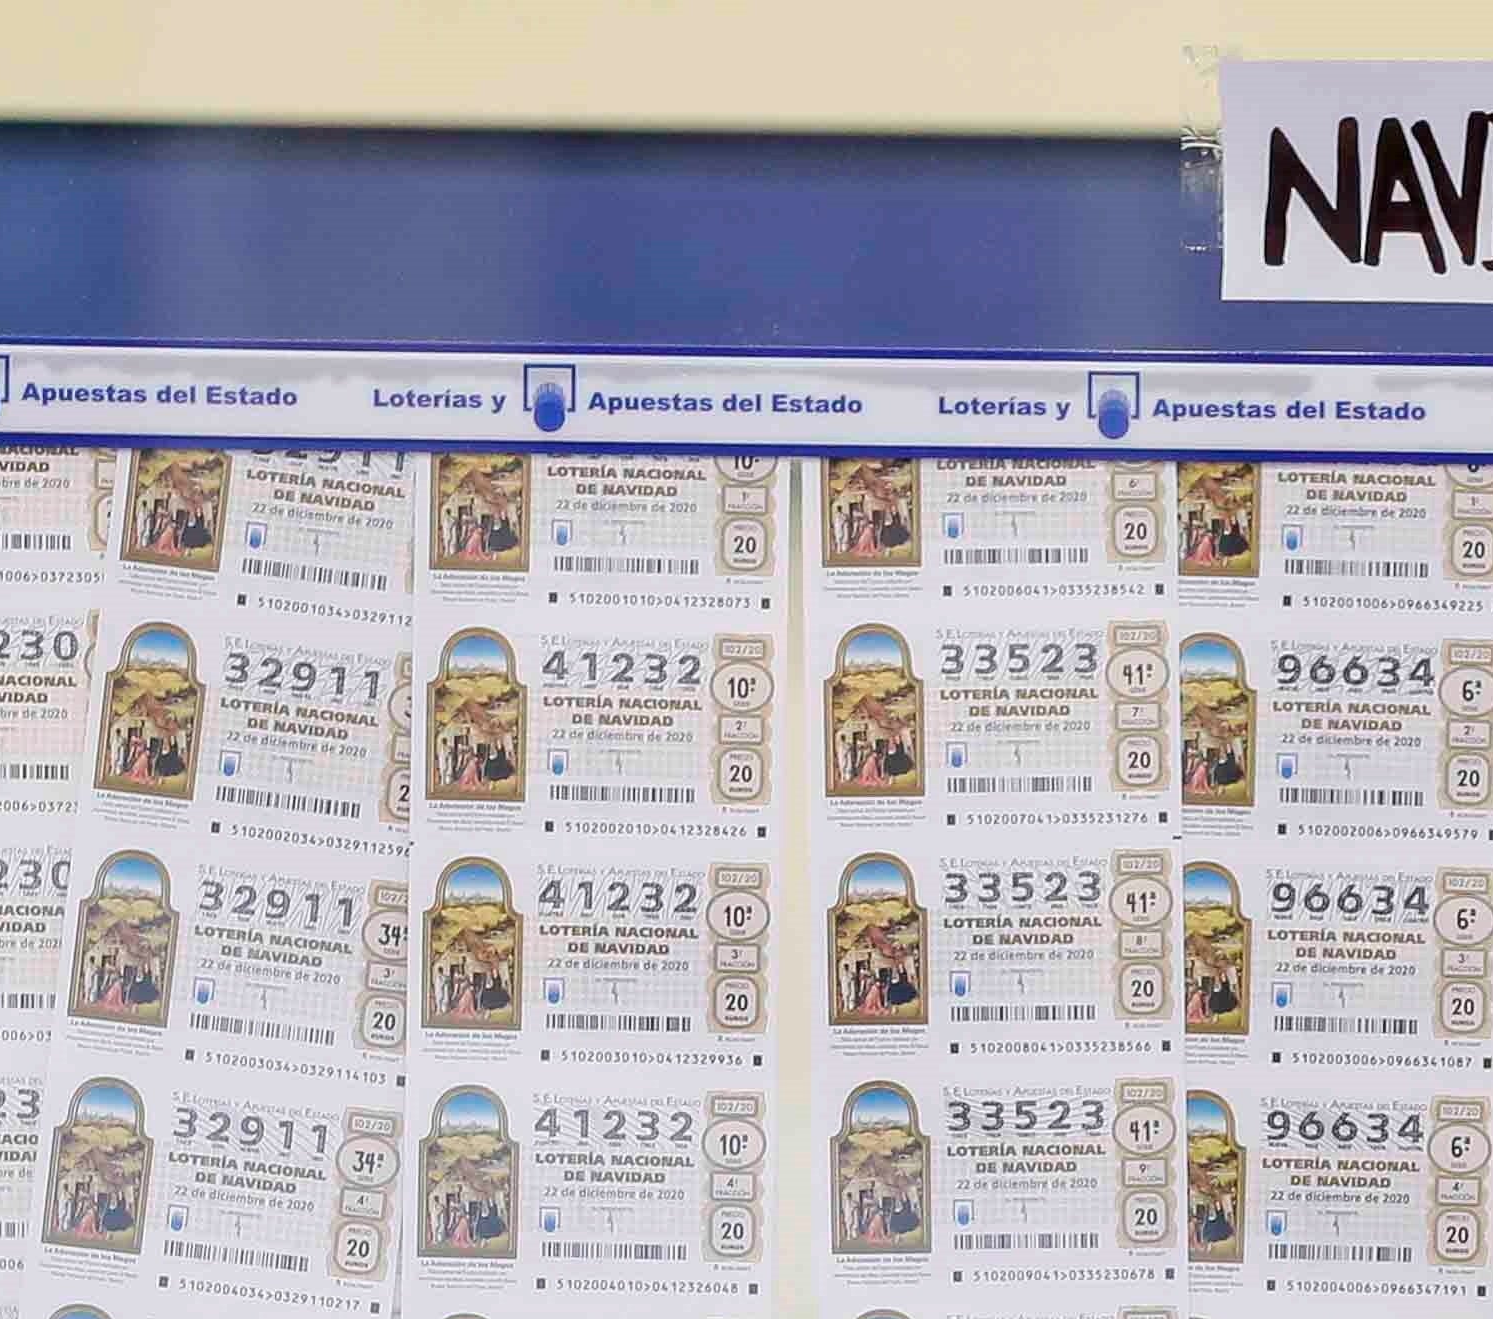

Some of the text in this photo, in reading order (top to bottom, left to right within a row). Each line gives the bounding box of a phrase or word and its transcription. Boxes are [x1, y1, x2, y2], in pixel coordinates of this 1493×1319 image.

[21, 382, 148, 406] Apuestas
[156, 385, 196, 404] del
[206, 385, 298, 406] Estado
[222, 651, 385, 701] 32911
[541, 649, 704, 688] 41232
[939, 642, 1100, 678] 33523
[1276, 652, 1436, 690] 96634
